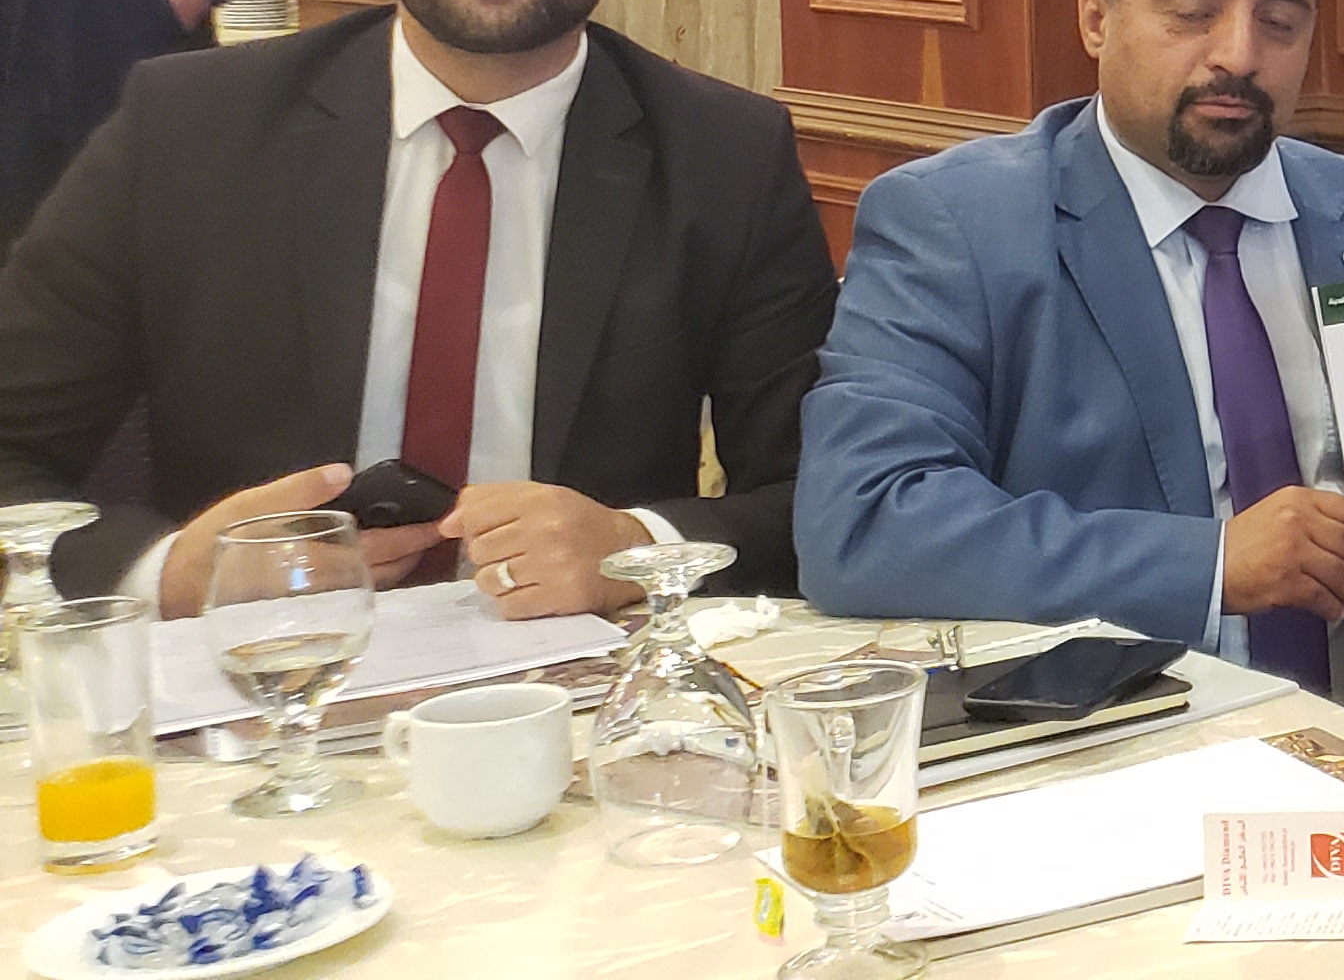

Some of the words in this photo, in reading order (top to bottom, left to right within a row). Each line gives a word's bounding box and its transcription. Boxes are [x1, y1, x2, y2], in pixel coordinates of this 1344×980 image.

[1220, 820, 1231, 865] Diamond
[1329, 837, 1343, 872] DIVA
[1222, 867, 1232, 896] DIVA
